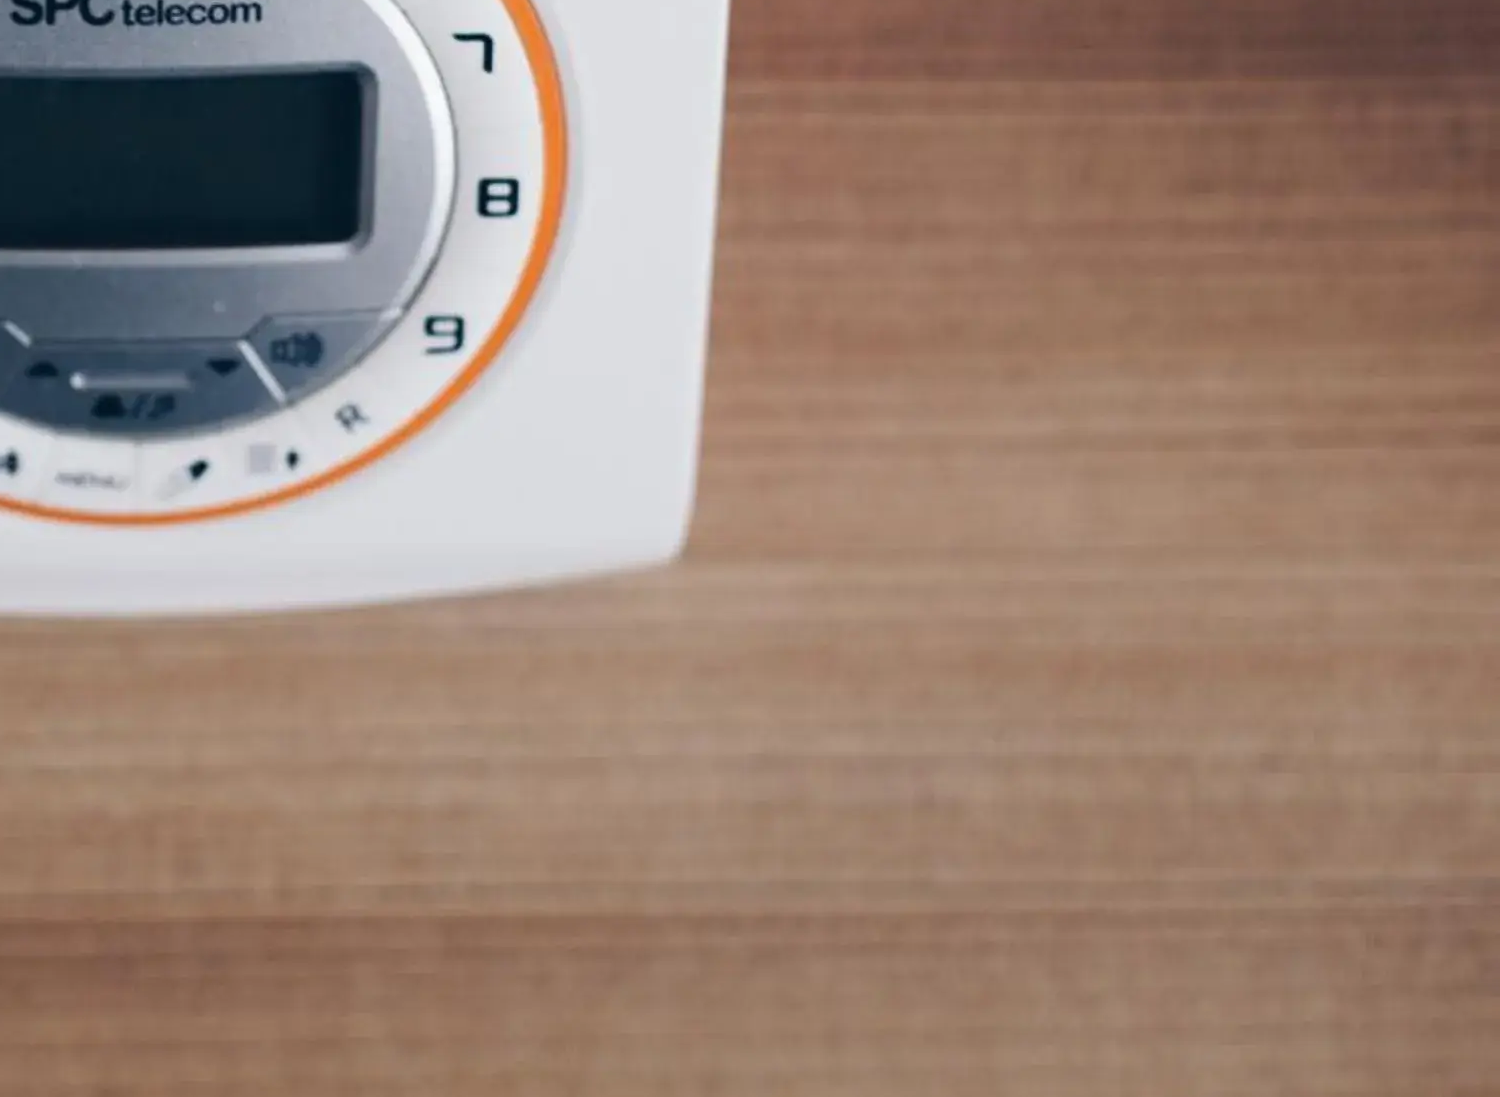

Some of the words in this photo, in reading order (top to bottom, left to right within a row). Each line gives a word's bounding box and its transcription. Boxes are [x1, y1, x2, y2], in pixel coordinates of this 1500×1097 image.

[452, 32, 495, 74] 7
[476, 177, 521, 218] 8
[423, 315, 466, 355] 9
[333, 402, 370, 433] R
